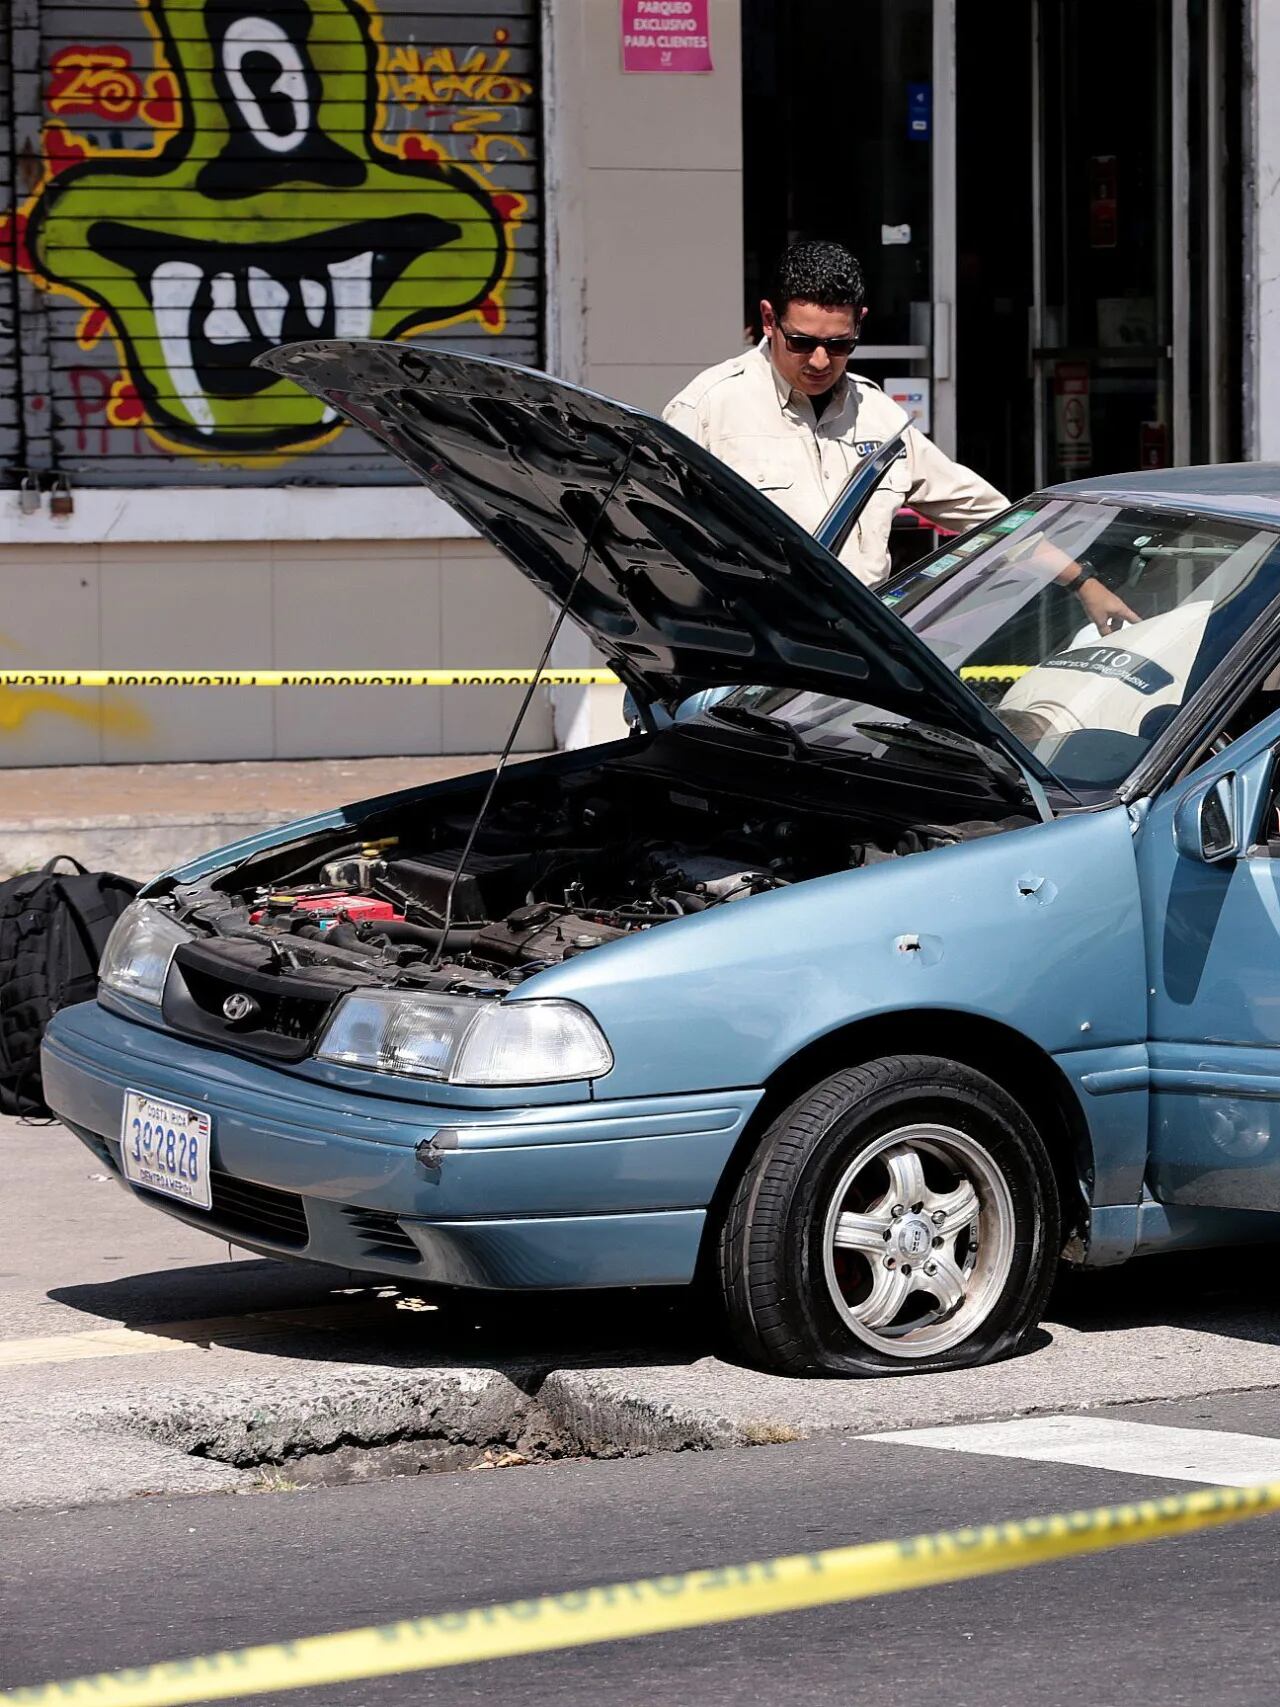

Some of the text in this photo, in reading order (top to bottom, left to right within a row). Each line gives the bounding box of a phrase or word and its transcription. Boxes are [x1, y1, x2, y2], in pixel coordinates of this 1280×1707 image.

[637, 1, 692, 16] PARQUEO
[633, 18, 697, 31] EXCLUSIVO
[624, 35, 707, 48] PARA CLIENTES
[1088, 649, 1132, 668] OIJ
[148, 1104, 187, 1126] COSTA RICA
